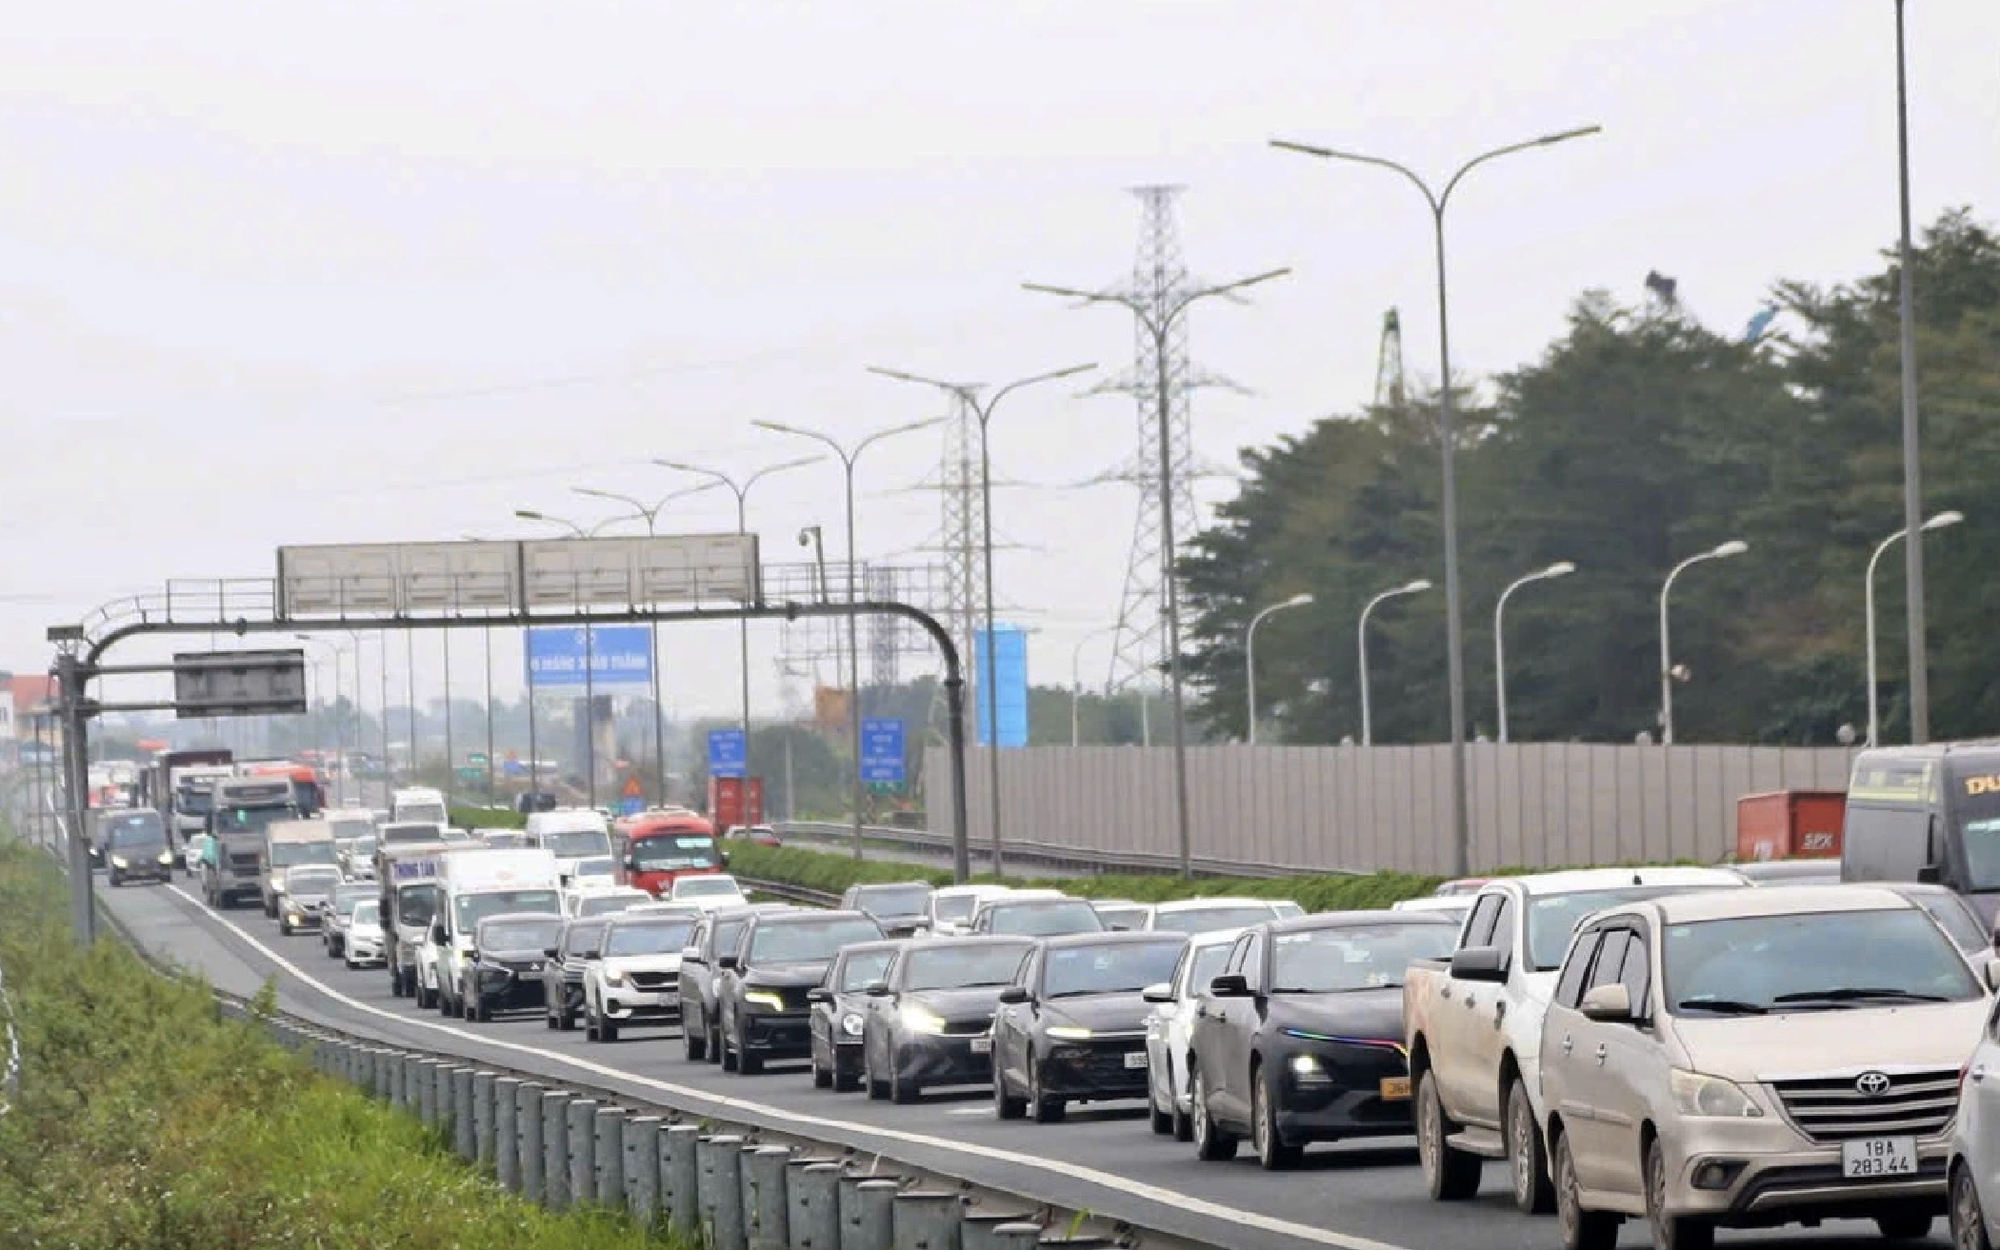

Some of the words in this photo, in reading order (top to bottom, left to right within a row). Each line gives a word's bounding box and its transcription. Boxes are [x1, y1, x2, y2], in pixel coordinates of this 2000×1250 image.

[1803, 832, 1832, 849] SPX
[1865, 1141, 1894, 1156] 18A
[1851, 1156, 1909, 1174] 283.44
